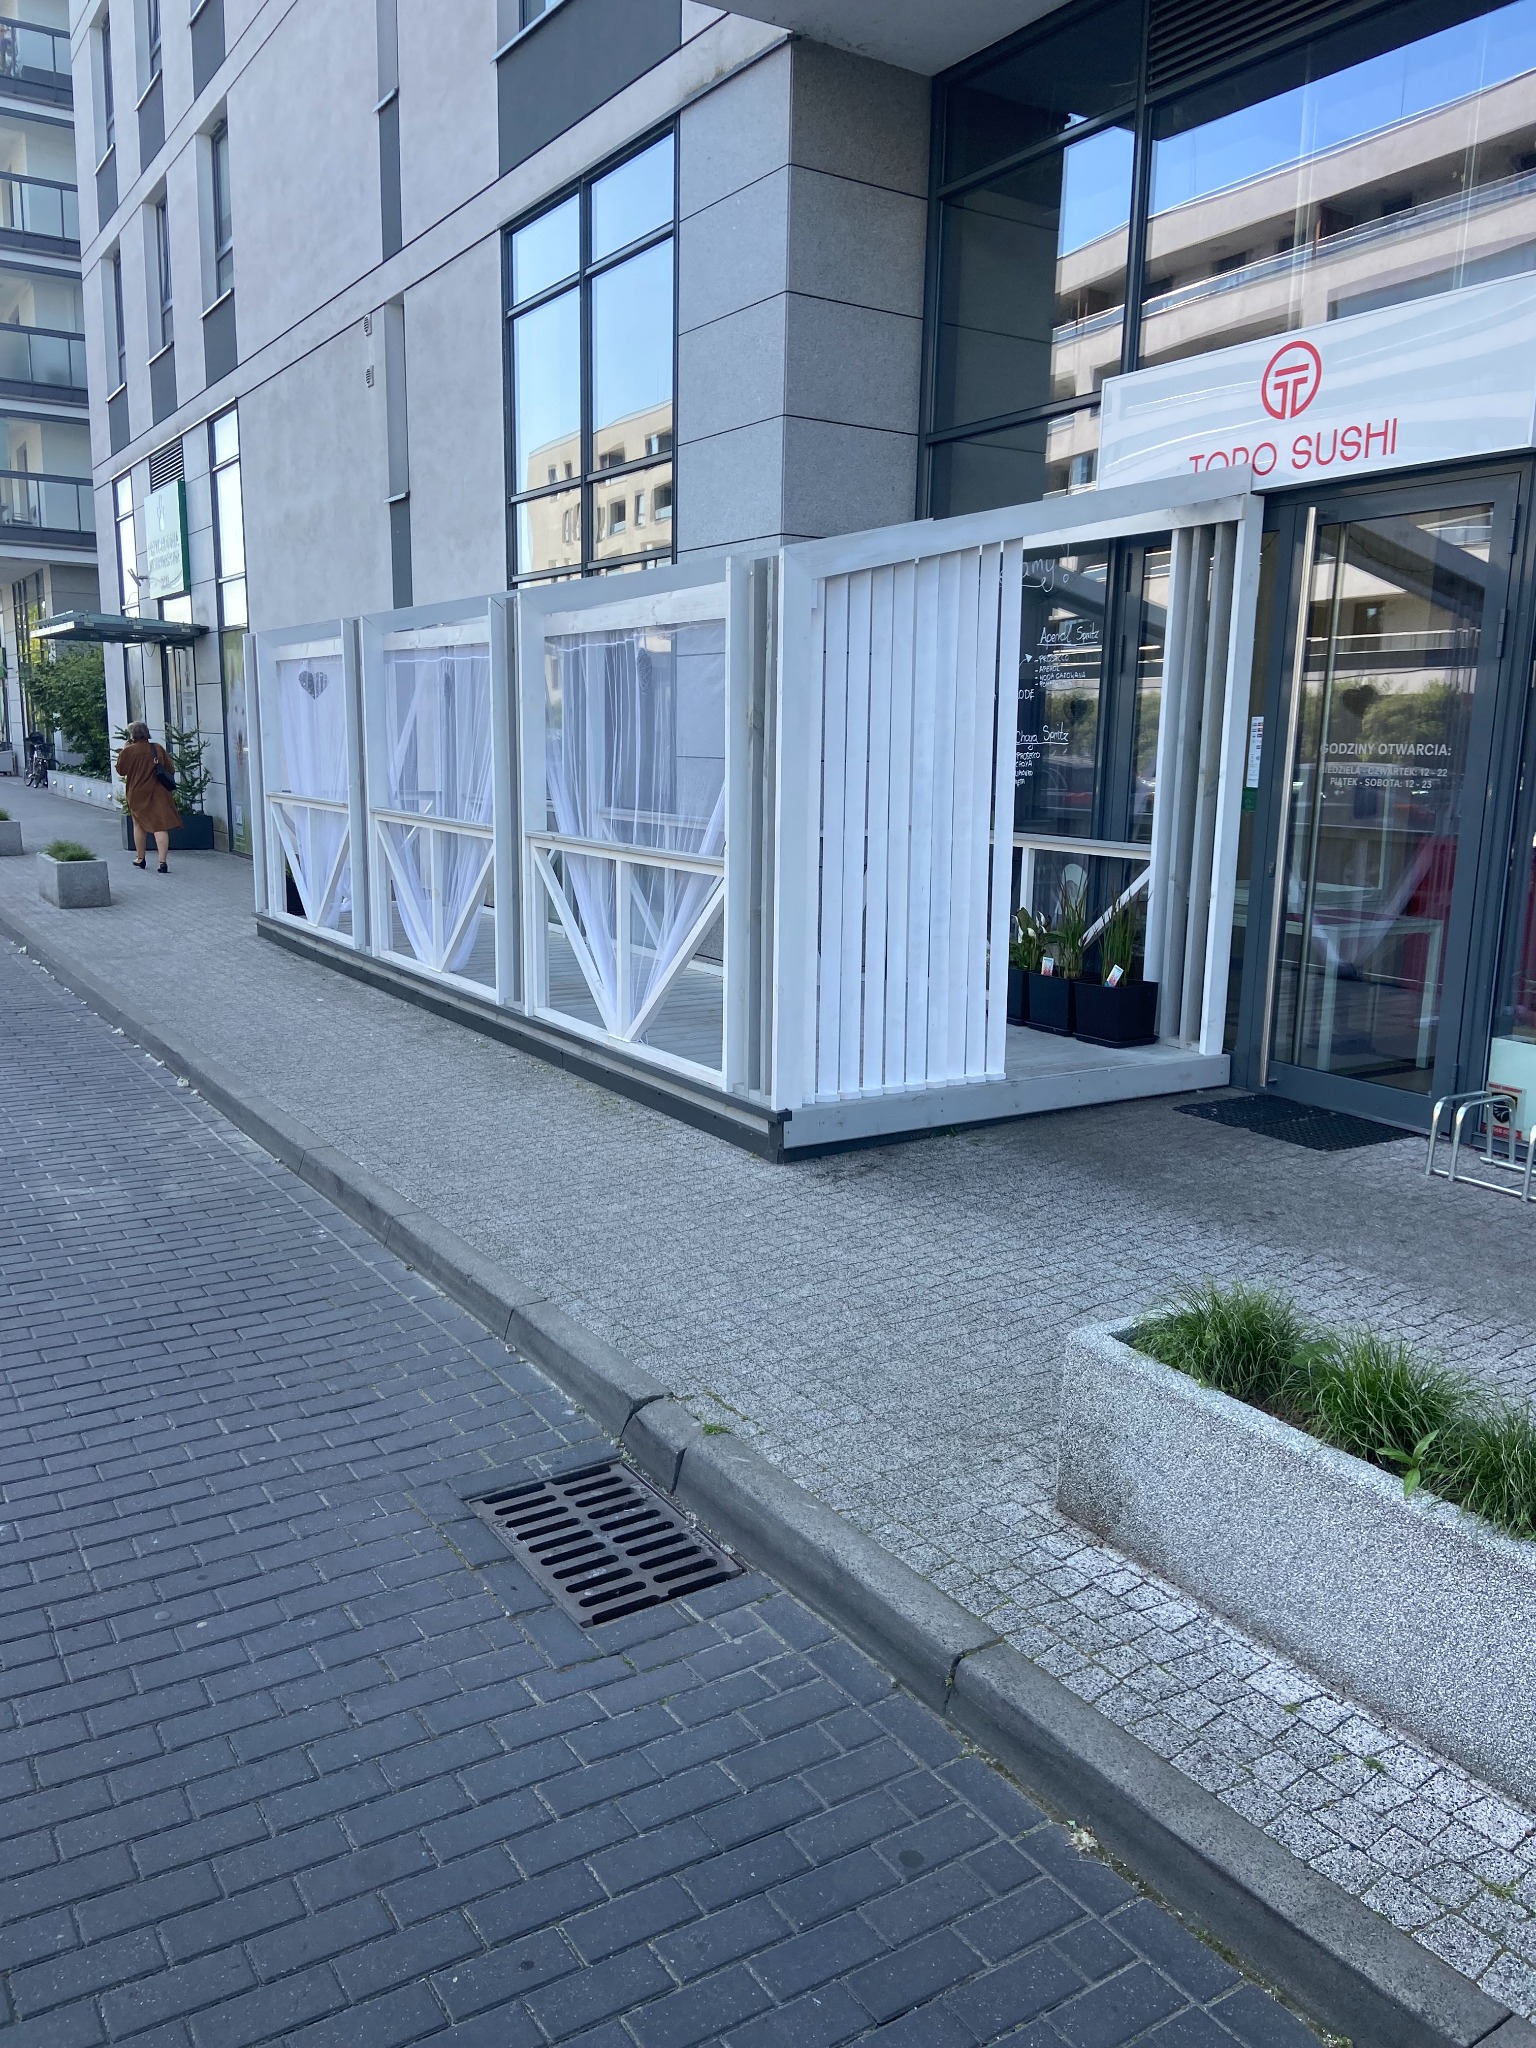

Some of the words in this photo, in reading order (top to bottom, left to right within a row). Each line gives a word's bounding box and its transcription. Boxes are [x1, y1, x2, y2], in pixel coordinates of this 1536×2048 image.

[1291, 418, 1398, 469] SUSHI
[1076, 622, 1100, 644] Spritz
[1043, 722, 1069, 745] Spritz
[1320, 742, 1375, 755] GODZINY
[1377, 743, 1452, 756] OTWARCIA:
[1319, 765, 1361, 775] IEDZIELA
[1367, 766, 1418, 776] CZWARTEK:
[1420, 767, 1430, 777] 12
[1437, 768, 1448, 777] 22
[1364, 778, 1403, 788] SOBOTA:
[1405, 779, 1415, 788] 12
[1421, 780, 1432, 789] 23
